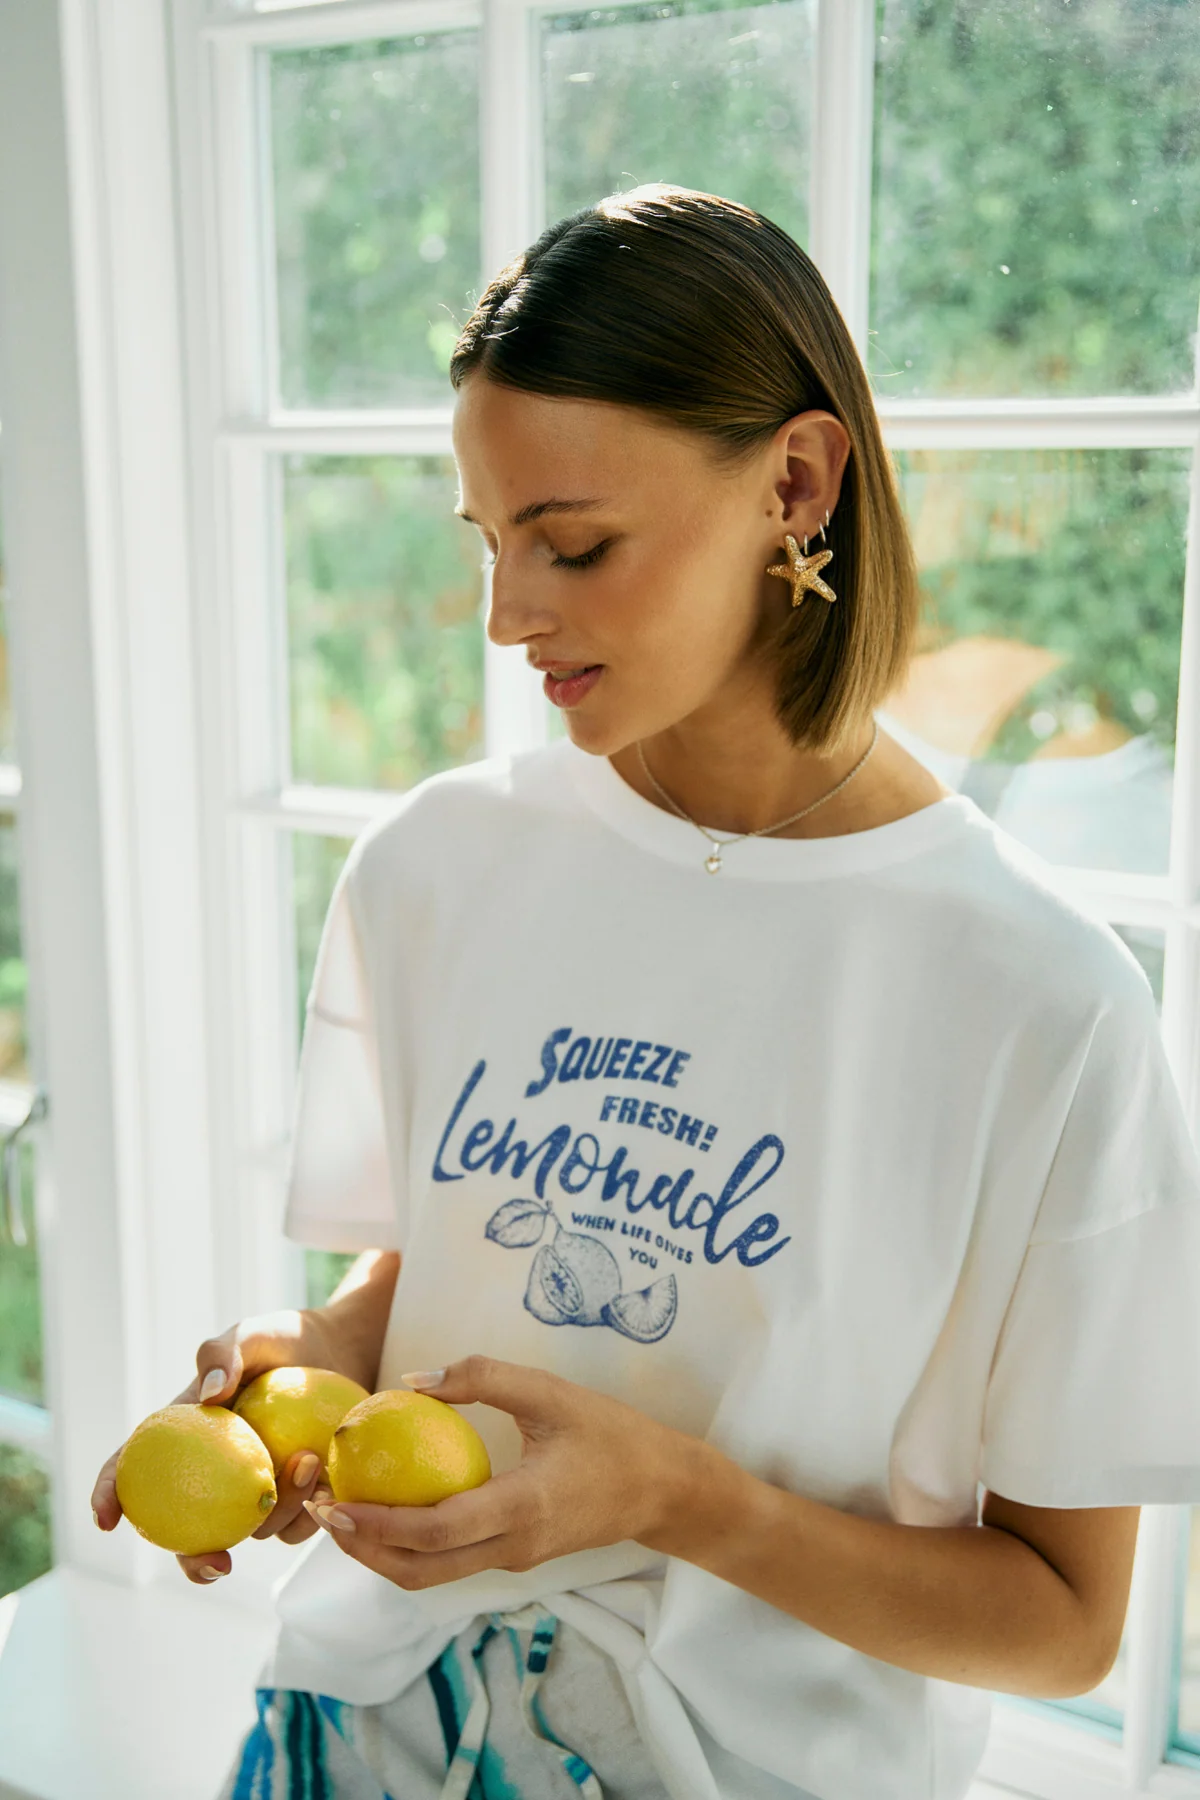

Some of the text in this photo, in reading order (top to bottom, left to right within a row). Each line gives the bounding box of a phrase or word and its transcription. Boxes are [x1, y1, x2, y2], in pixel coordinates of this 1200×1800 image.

[524, 1028, 691, 1098] SQUEEZE
[600, 1096, 718, 1152] FRESH!
[432, 1059, 792, 1267] Lemonade
[571, 1212, 693, 1264] WHEN LIFE GIVES
[629, 1248, 658, 1269] YOU
